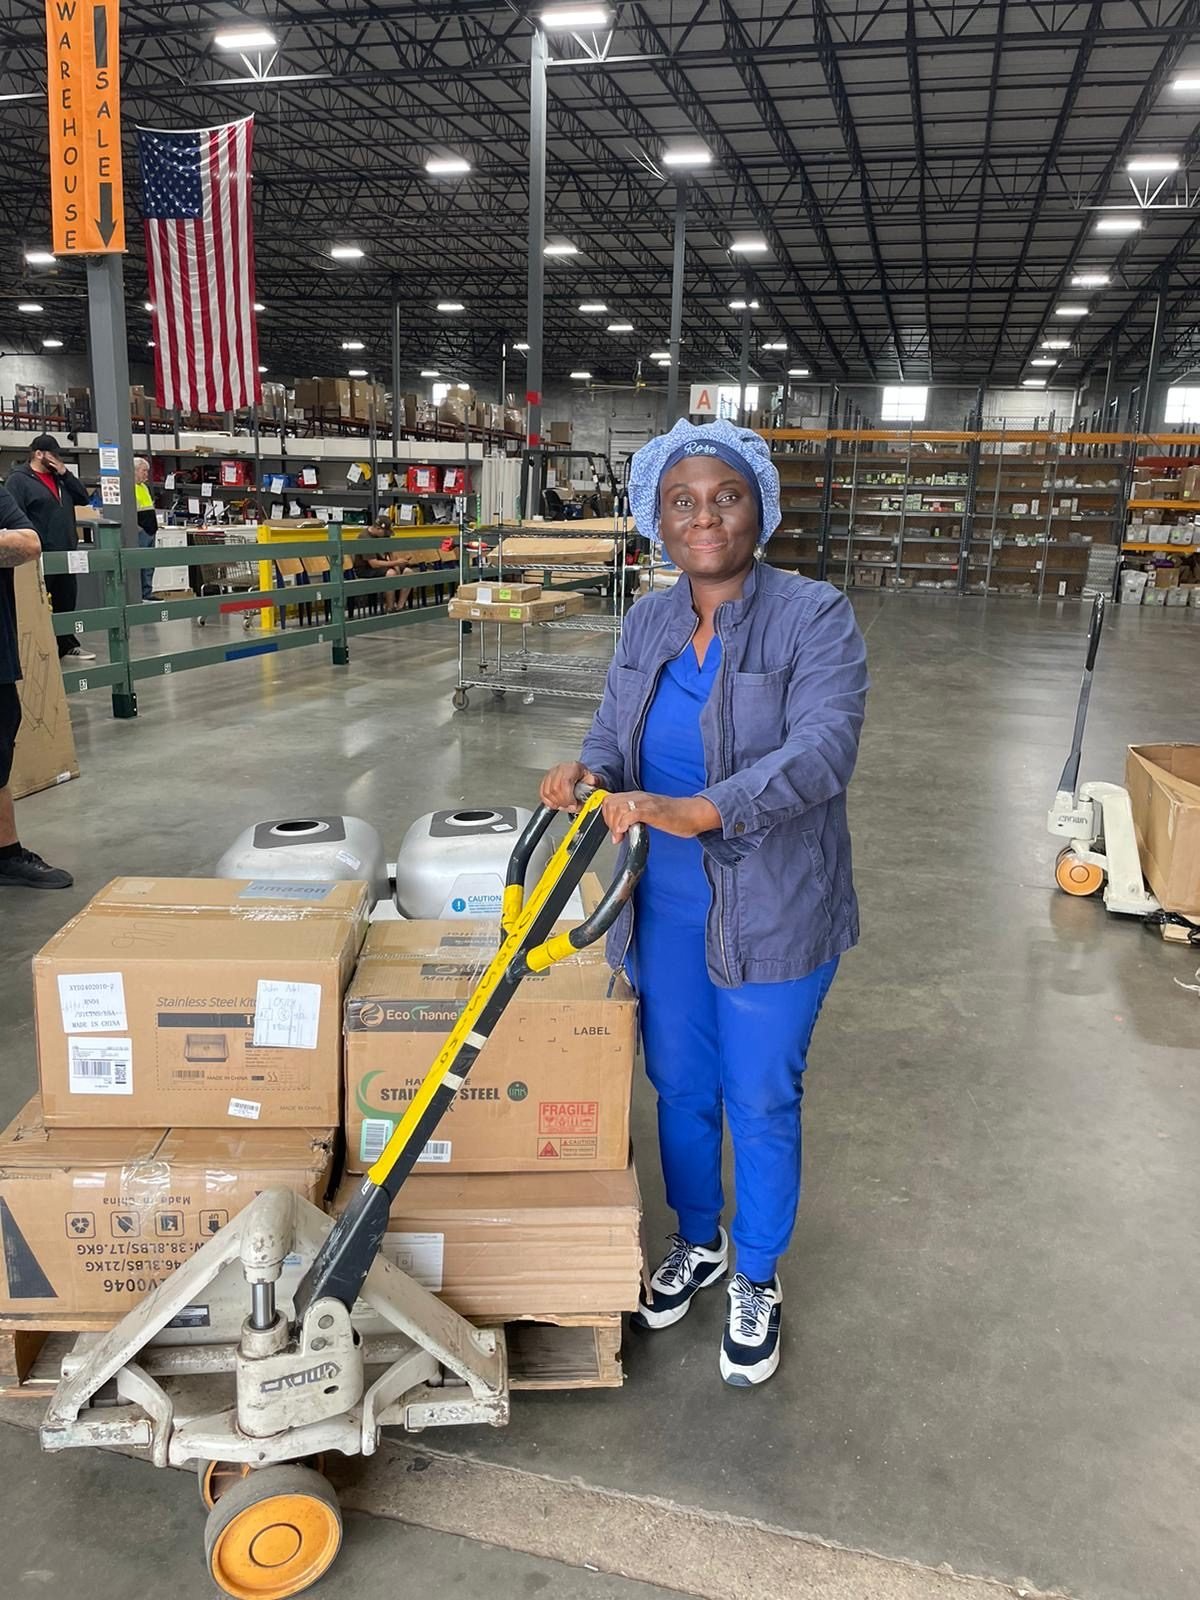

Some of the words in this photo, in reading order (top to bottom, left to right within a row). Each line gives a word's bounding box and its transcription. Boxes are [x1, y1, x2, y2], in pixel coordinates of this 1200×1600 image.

[56, 2, 78, 249] WAREHOUSE
[95, 71, 111, 177] SALE
[696, 389, 711, 409] A
[684, 441, 717, 454] Rose
[156, 996, 207, 1008] Stainless
[208, 996, 238, 1008] Steel
[573, 1027, 610, 1036] LABEL
[460, 1088, 500, 1100] STEEL
[542, 1104, 595, 1116] FRAGILE
[161, 1196, 191, 1205] Made
[77, 1241, 186, 1255] 38.8LBS/17.6KG
